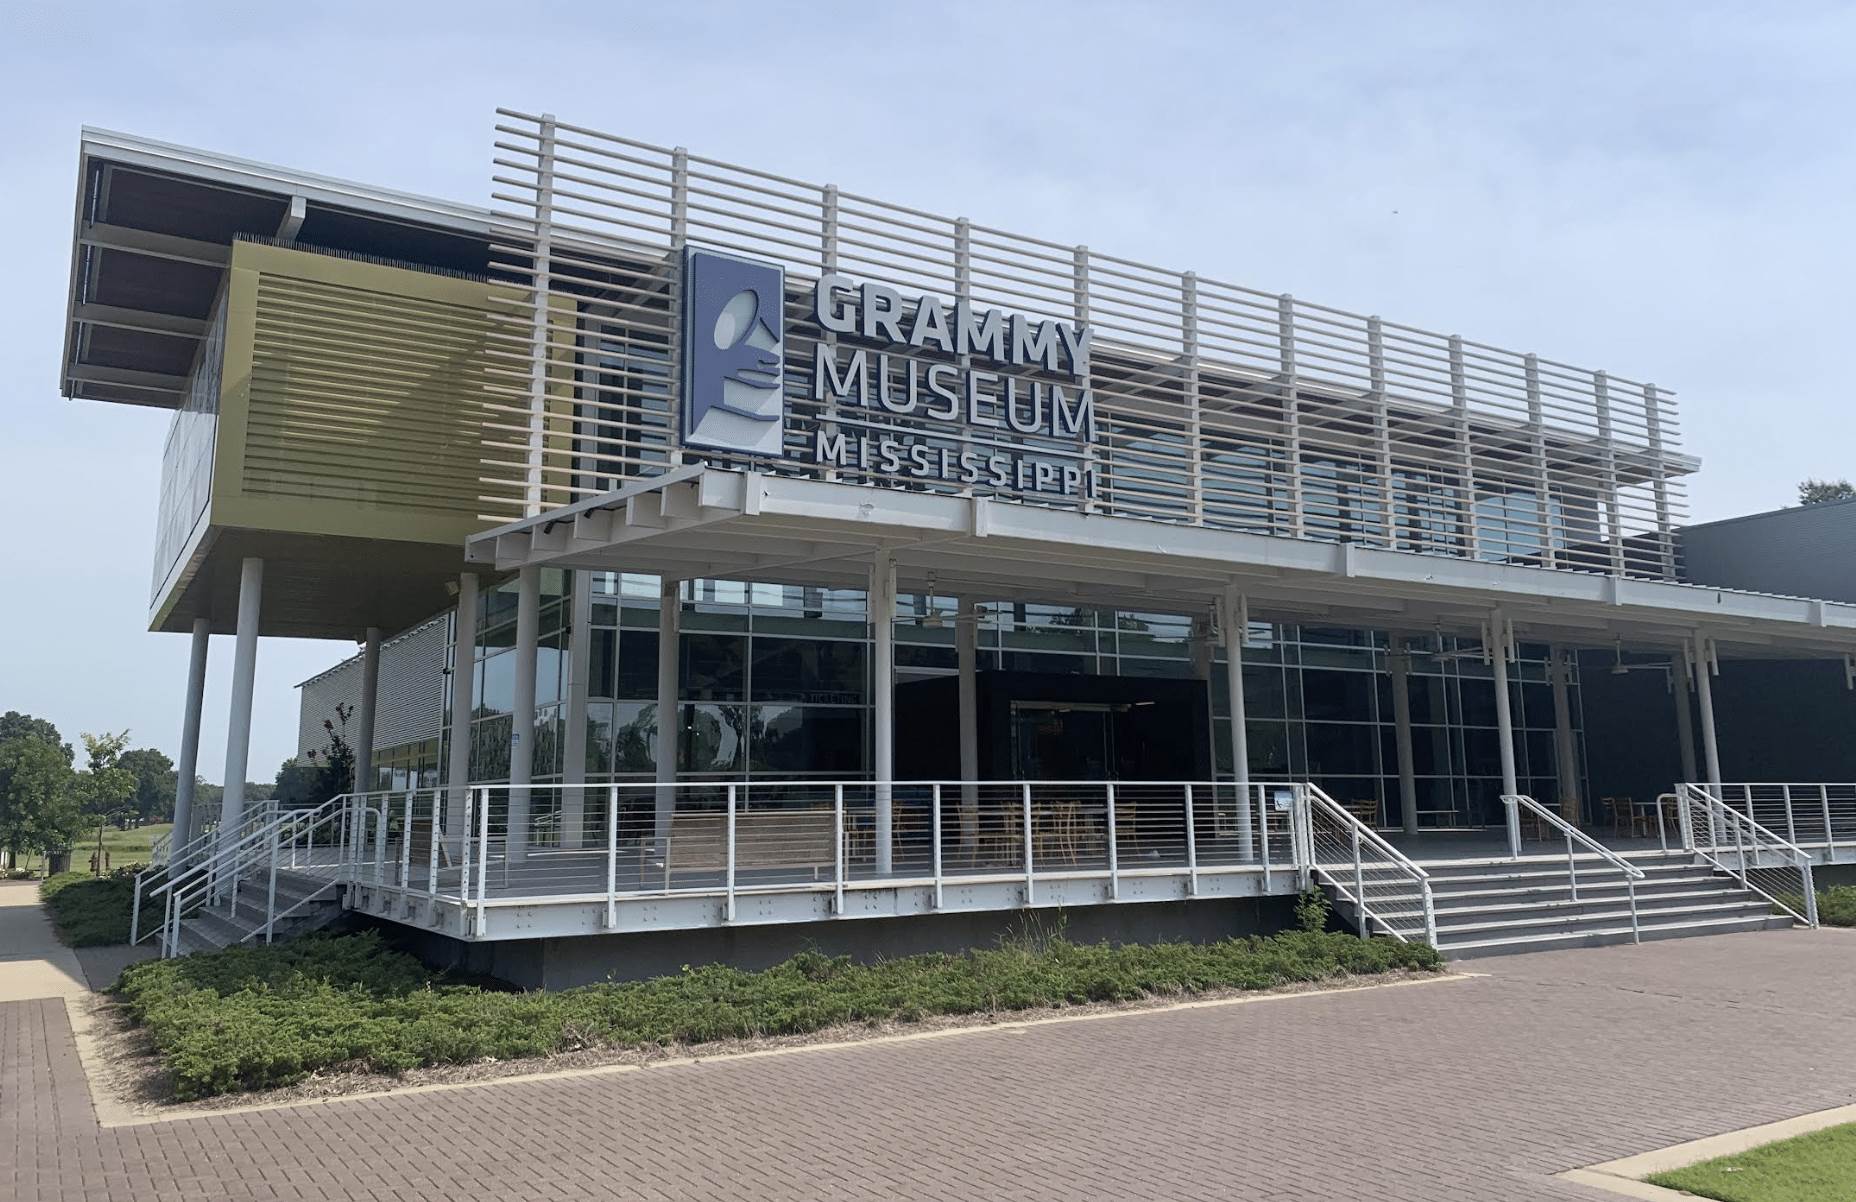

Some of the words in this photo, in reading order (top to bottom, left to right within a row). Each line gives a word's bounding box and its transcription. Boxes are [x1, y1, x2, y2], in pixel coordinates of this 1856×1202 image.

[815, 274, 1093, 377] GRAMMY
[815, 343, 1097, 442] MUSEUM
[815, 432, 1097, 498] MISSISSIPPI
